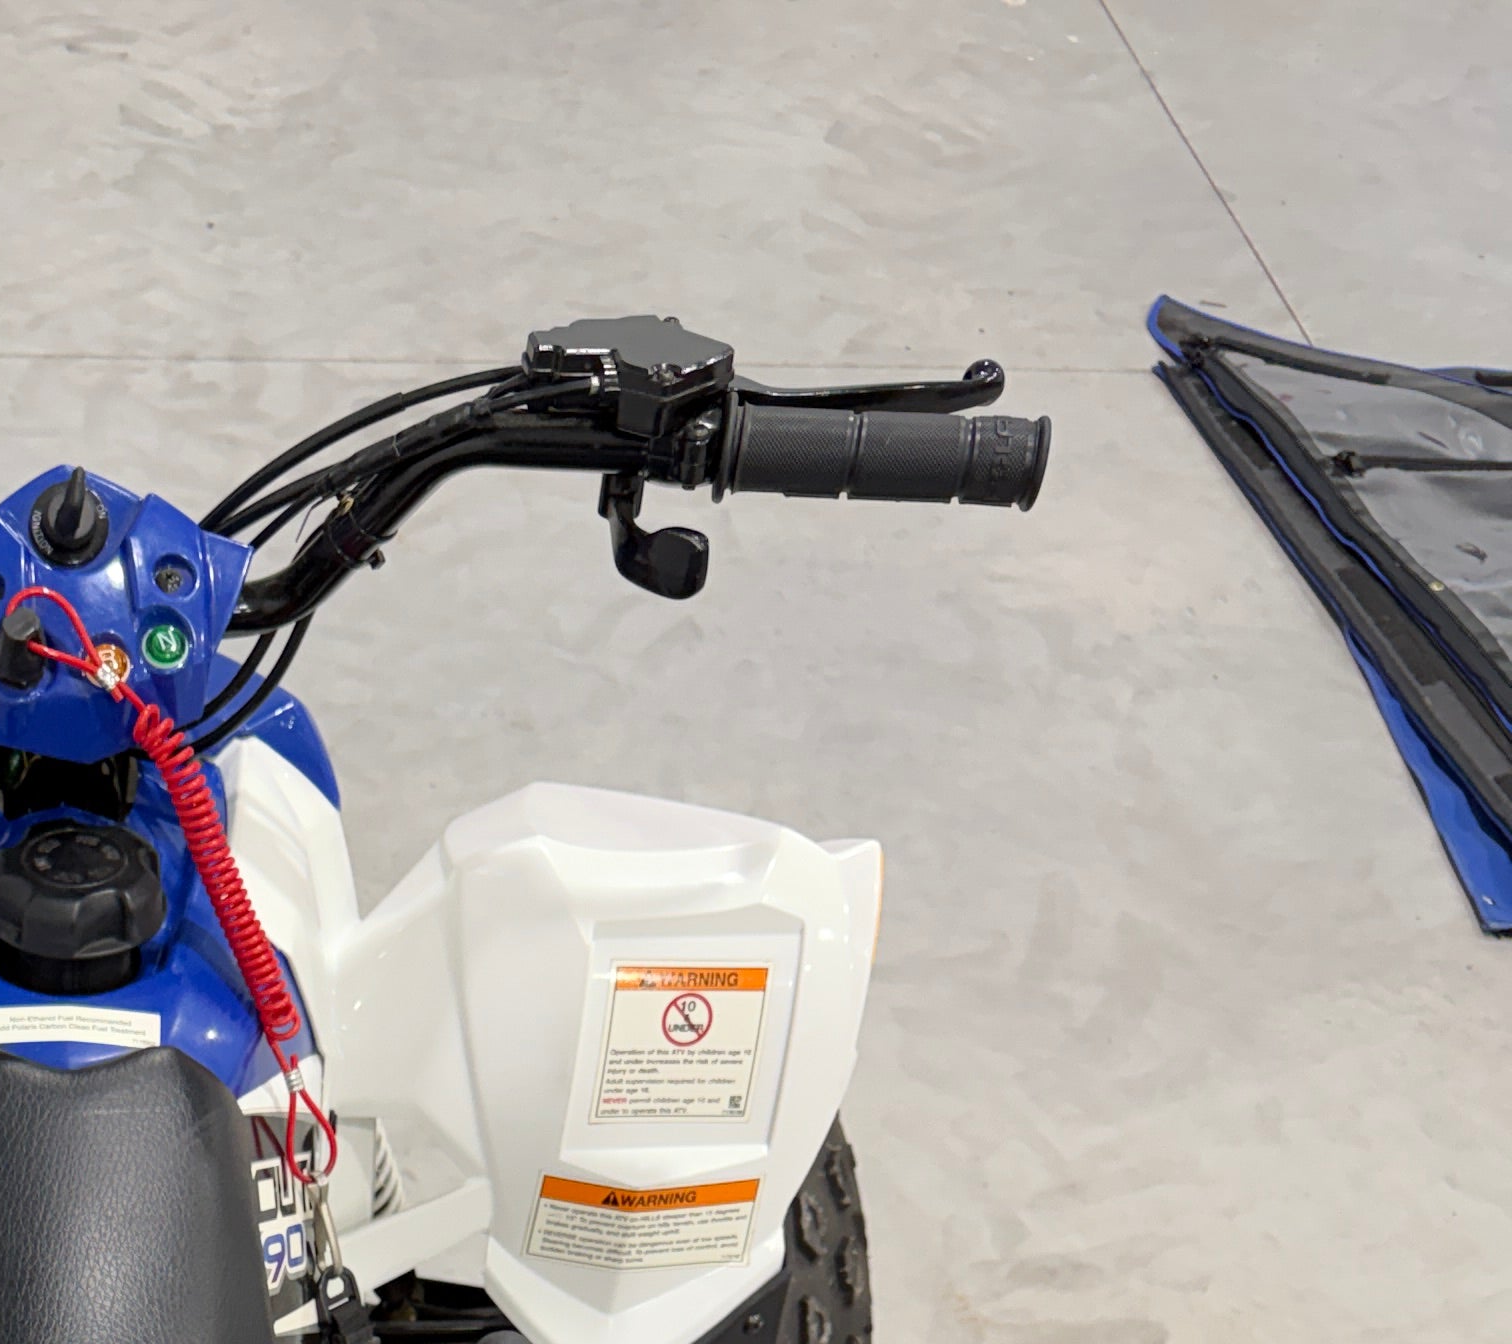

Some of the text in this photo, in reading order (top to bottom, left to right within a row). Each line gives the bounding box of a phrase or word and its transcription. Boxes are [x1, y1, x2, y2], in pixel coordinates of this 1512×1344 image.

[156, 627, 177, 652] N
[660, 972, 738, 987] WARNING
[680, 1001, 696, 1012] 10
[621, 1190, 697, 1207] WARNING
[262, 1222, 306, 1286] 90
